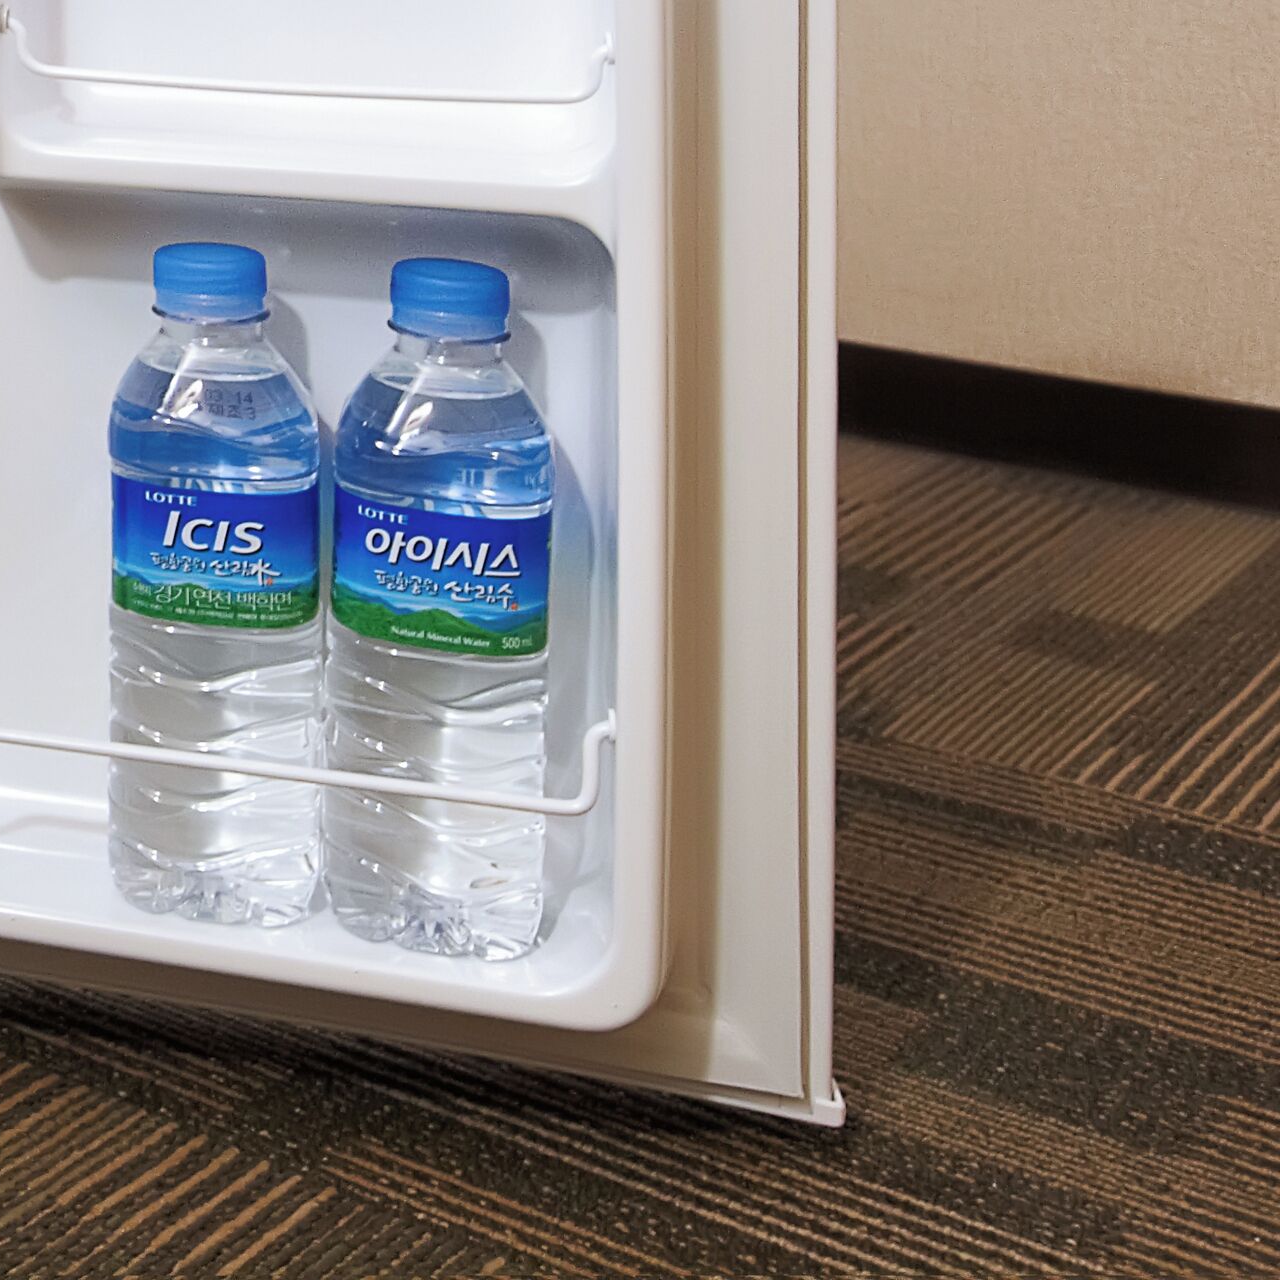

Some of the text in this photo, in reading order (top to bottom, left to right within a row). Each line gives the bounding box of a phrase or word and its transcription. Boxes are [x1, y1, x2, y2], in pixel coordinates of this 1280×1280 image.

[145, 490, 197, 507] LOTTE
[358, 504, 408, 525] LOTTE
[162, 510, 265, 555] ICIS
[365, 527, 522, 577] 아이시스
[390, 625, 425, 640] Natural
[426, 631, 462, 645] Mineral
[463, 636, 491, 649] Water
[502, 636, 521, 651] 500
